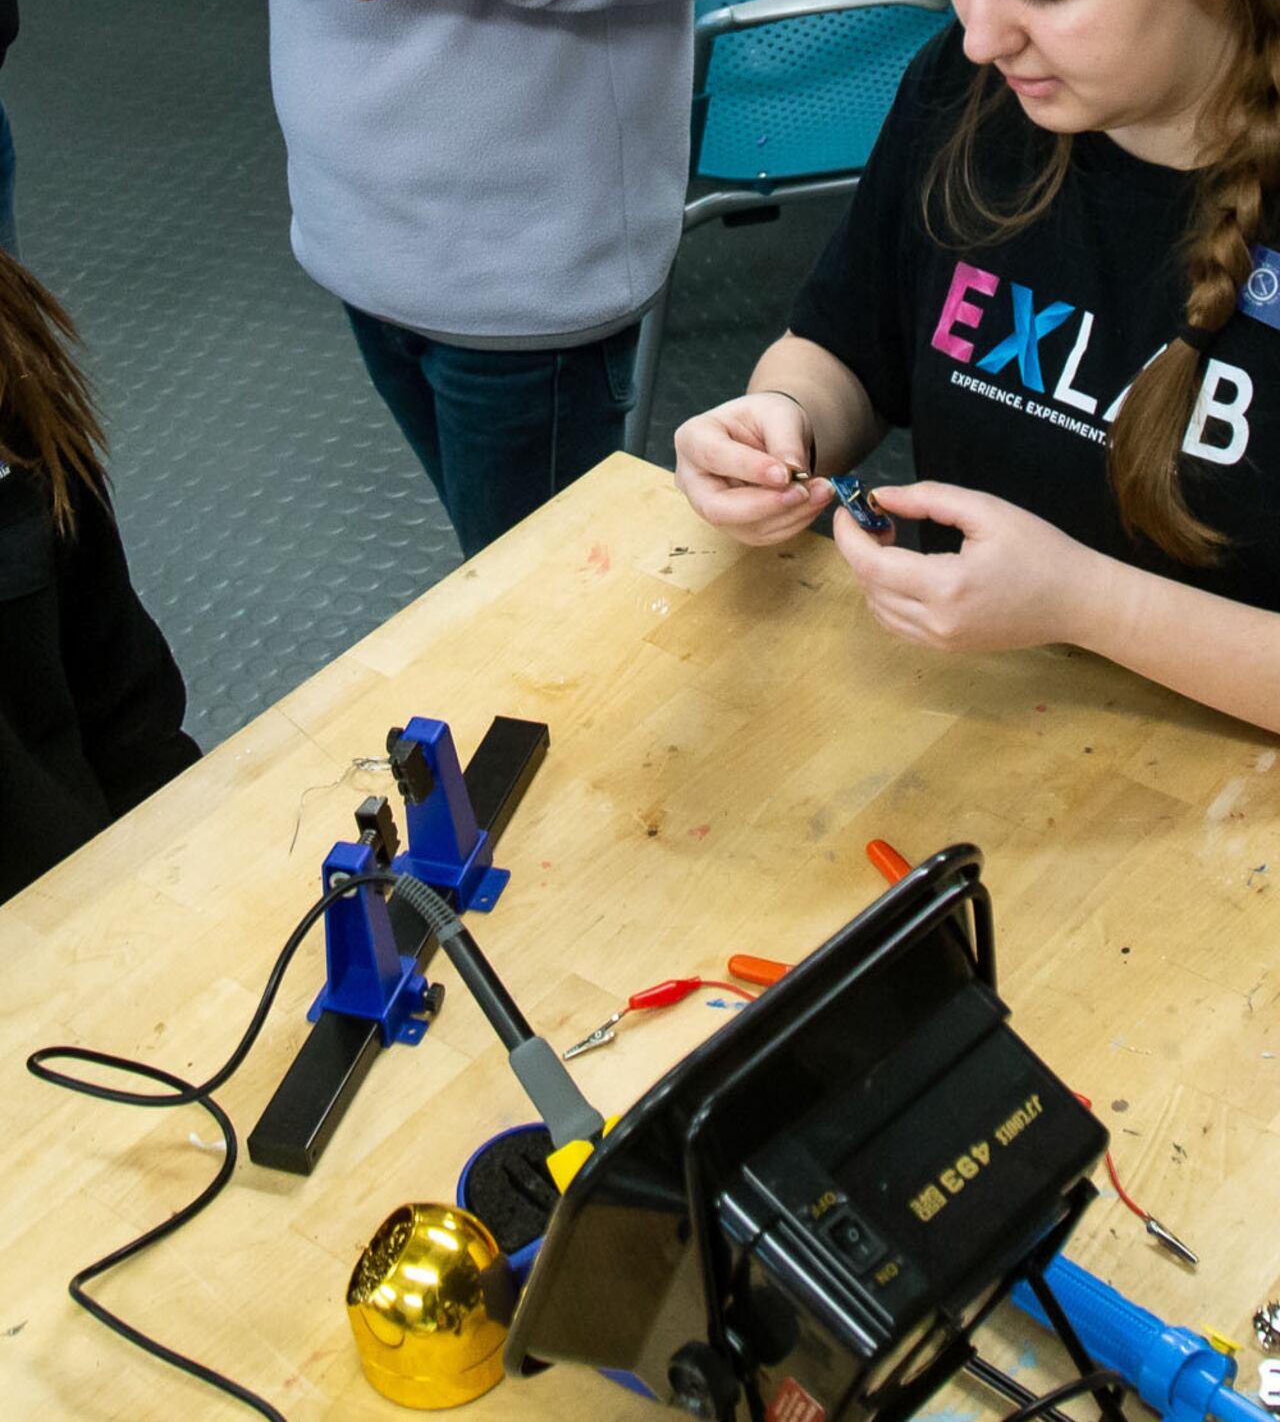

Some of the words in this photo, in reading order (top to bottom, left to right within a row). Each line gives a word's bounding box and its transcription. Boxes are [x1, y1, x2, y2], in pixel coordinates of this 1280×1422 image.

[931, 261, 1254, 466] EXLB
[950, 370, 1023, 411] EXPERIENCE.
[1025, 400, 1107, 446] EXPERIMENT.
[938, 1140, 991, 1195] 493
[811, 1190, 838, 1219] OFF
[875, 1261, 899, 1285] ON
